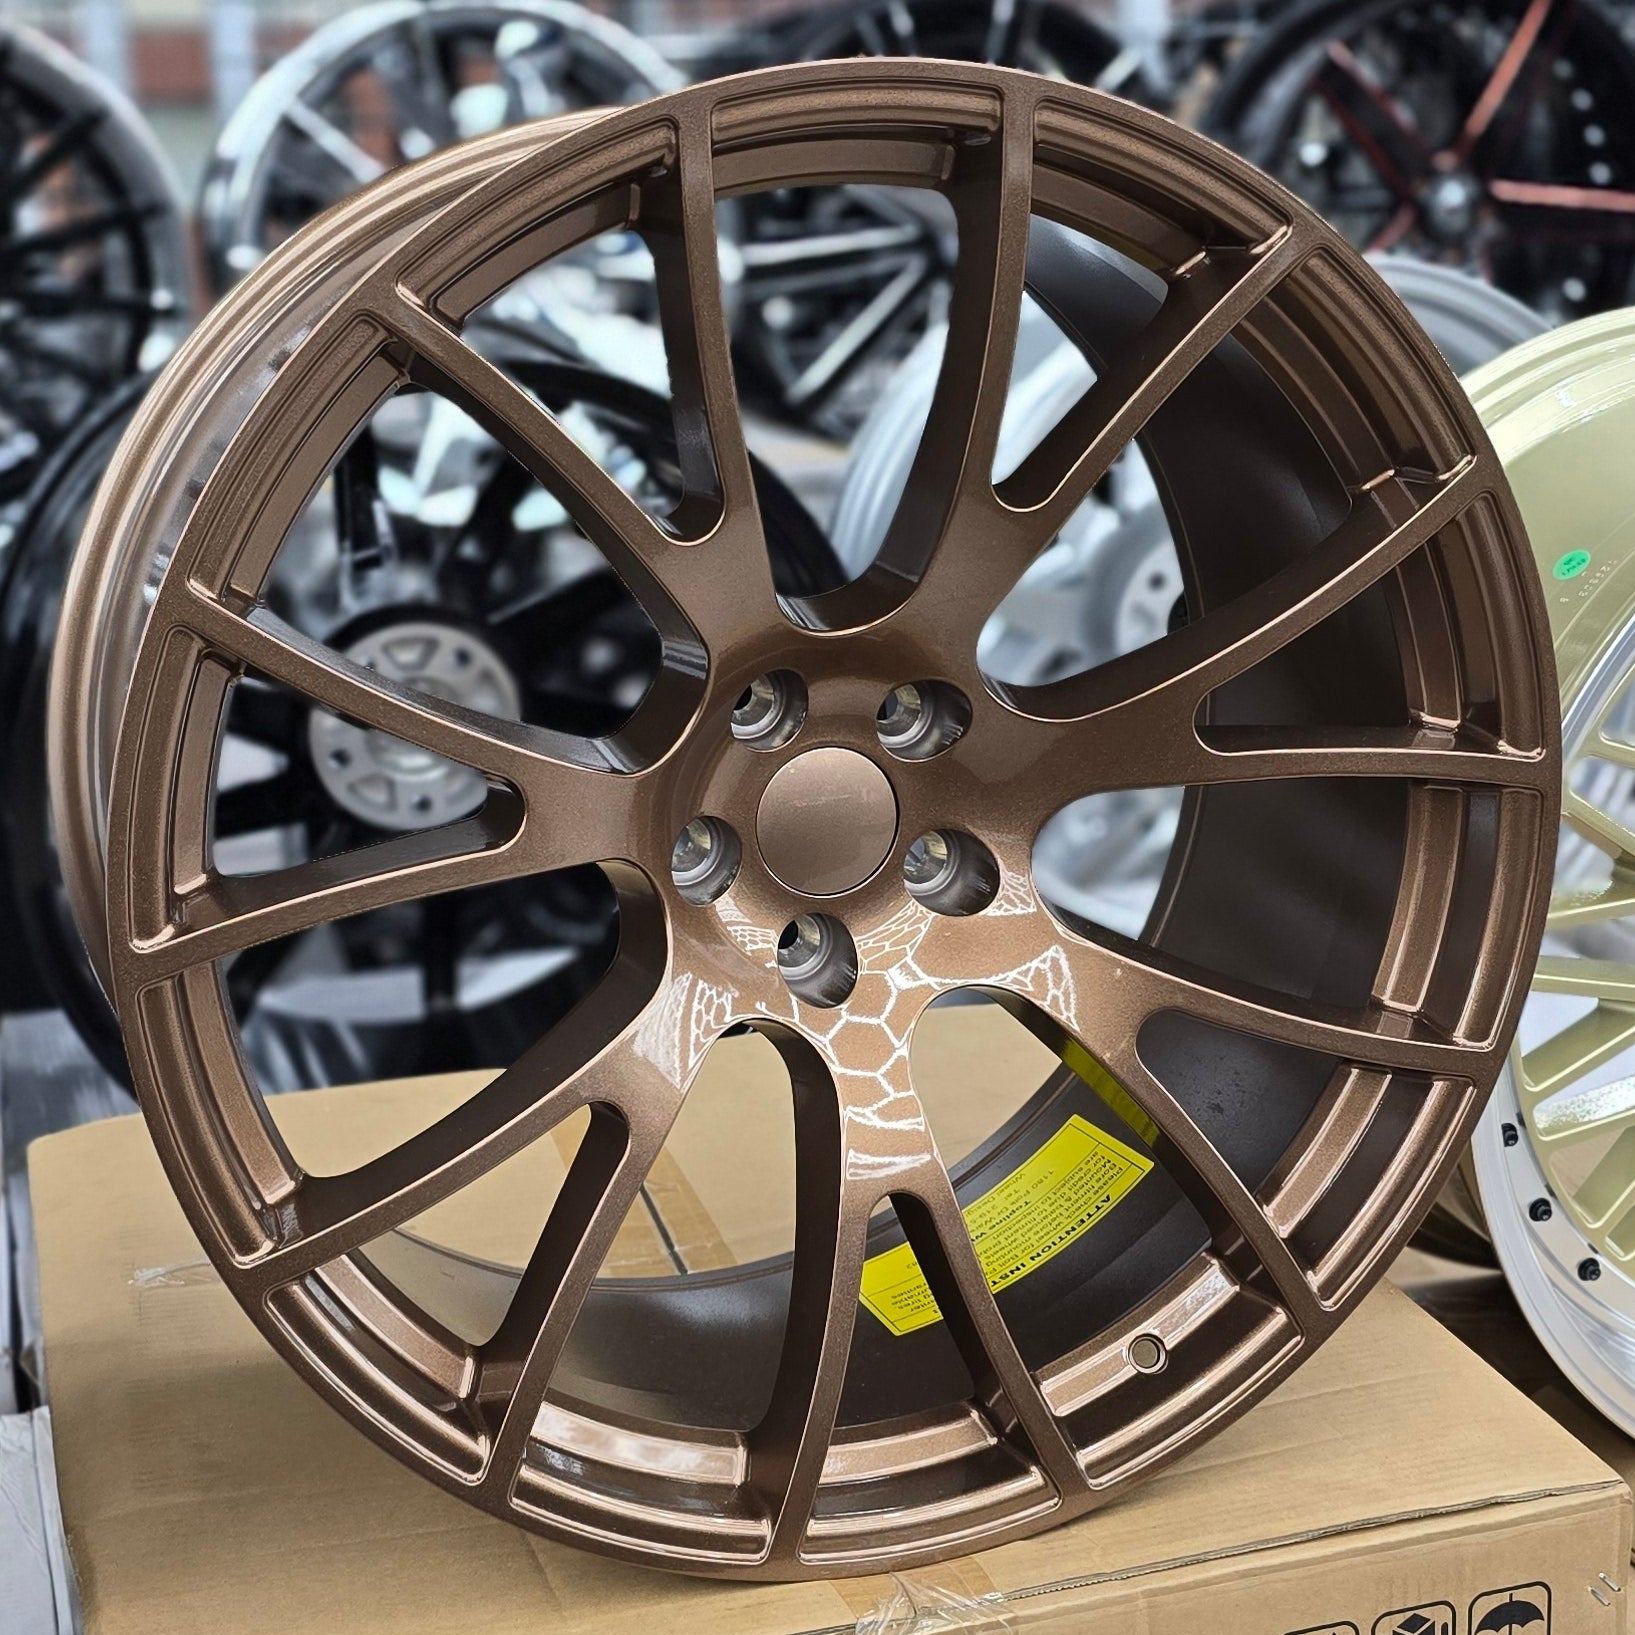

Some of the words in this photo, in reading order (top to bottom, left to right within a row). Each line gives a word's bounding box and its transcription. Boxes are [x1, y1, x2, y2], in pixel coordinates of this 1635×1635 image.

[1083, 1150, 1099, 1166] are
[1091, 1154, 1105, 1168] for
[1050, 1165, 1084, 1196] subject
[1066, 1167, 1093, 1191] credit
[1072, 1158, 1111, 1196] Mounted
[1092, 1166, 1123, 1197] Please
[1094, 1162, 1116, 1184] Bore
[1047, 1191, 1068, 1208] due
[1063, 1184, 1095, 1212] fitment
[1064, 1195, 1093, 1220] check
[986, 1198, 1031, 1230] Topline
[1019, 1203, 1064, 1237] balanced
[1031, 1211, 1064, 1236] before
[1002, 1216, 1037, 1241] fitment
[1028, 1193, 1112, 1262] ATTENTION
[1034, 1220, 1064, 1243] wheel
[977, 1239, 1002, 1256] prob
[983, 1236, 1019, 1260] wheels
[984, 1235, 1033, 1267] mounting
[1019, 1242, 1035, 1254] for
[997, 1253, 1019, 1268] Bolt
[987, 1262, 1026, 1287] INST
